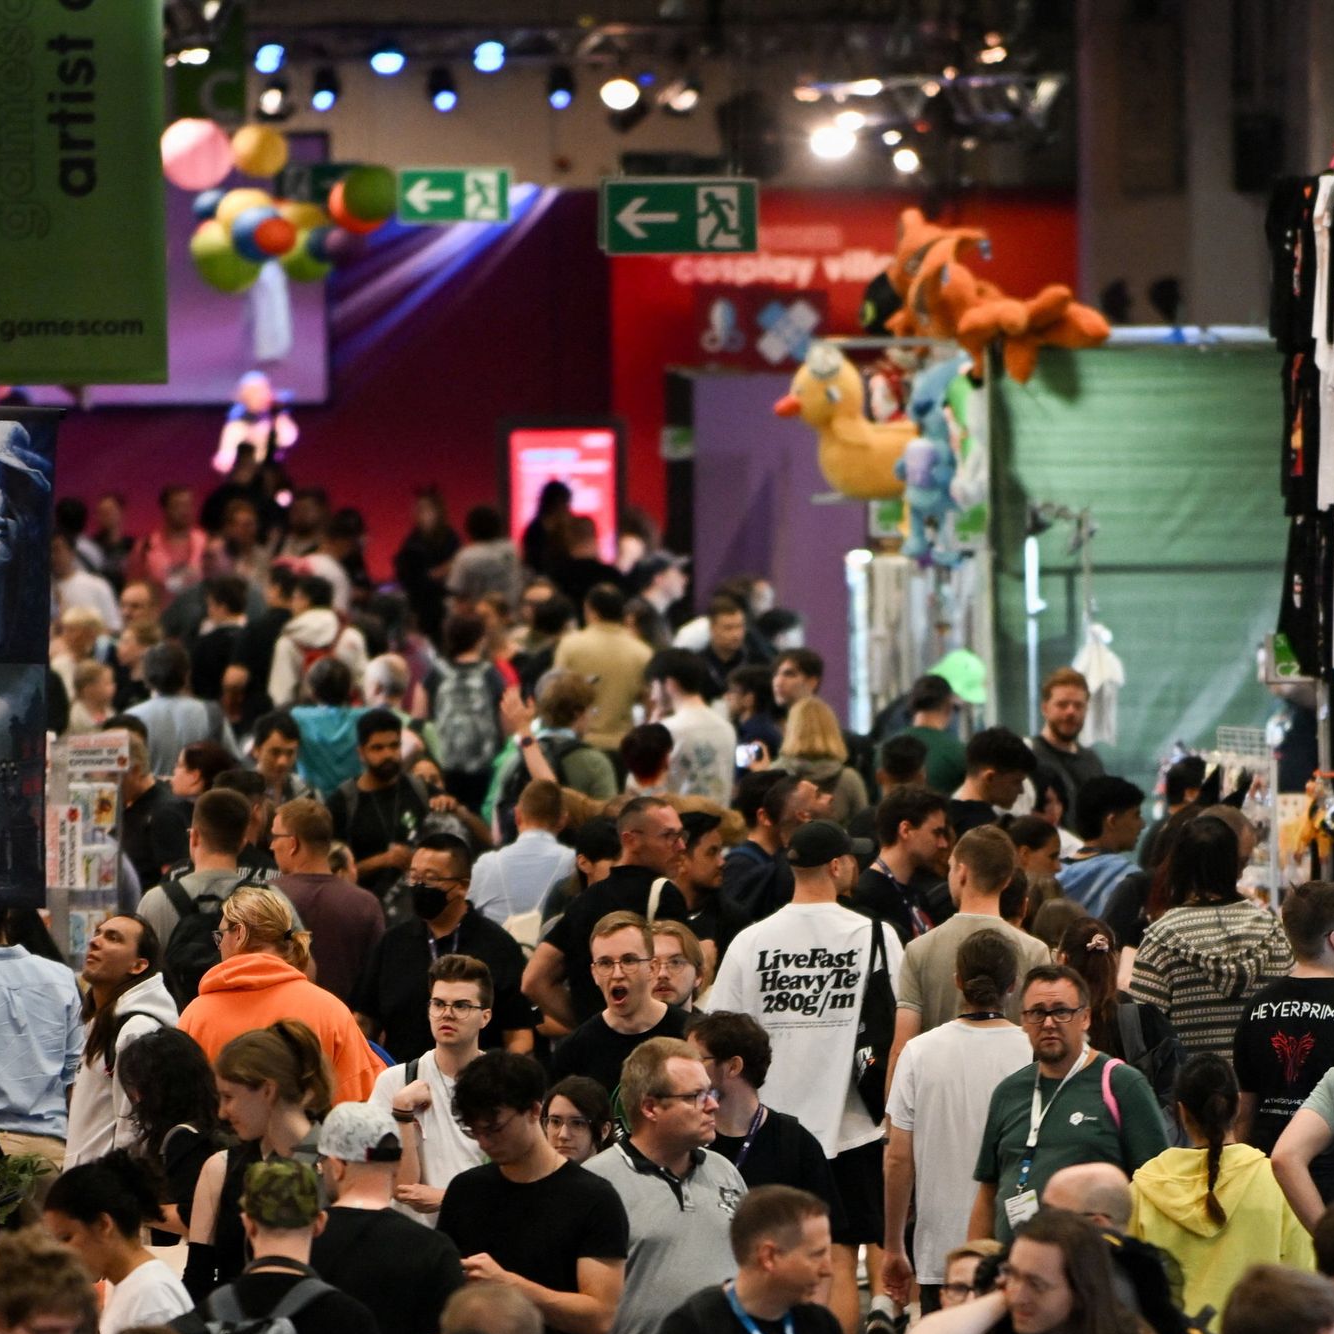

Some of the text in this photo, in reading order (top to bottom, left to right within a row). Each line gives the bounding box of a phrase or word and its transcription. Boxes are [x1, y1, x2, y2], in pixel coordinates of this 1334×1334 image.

[45, 33, 97, 198] artist
[1275, 662, 1301, 678] C2
[756, 947, 859, 972] LiveFast
[762, 991, 856, 1018] 280g/m
